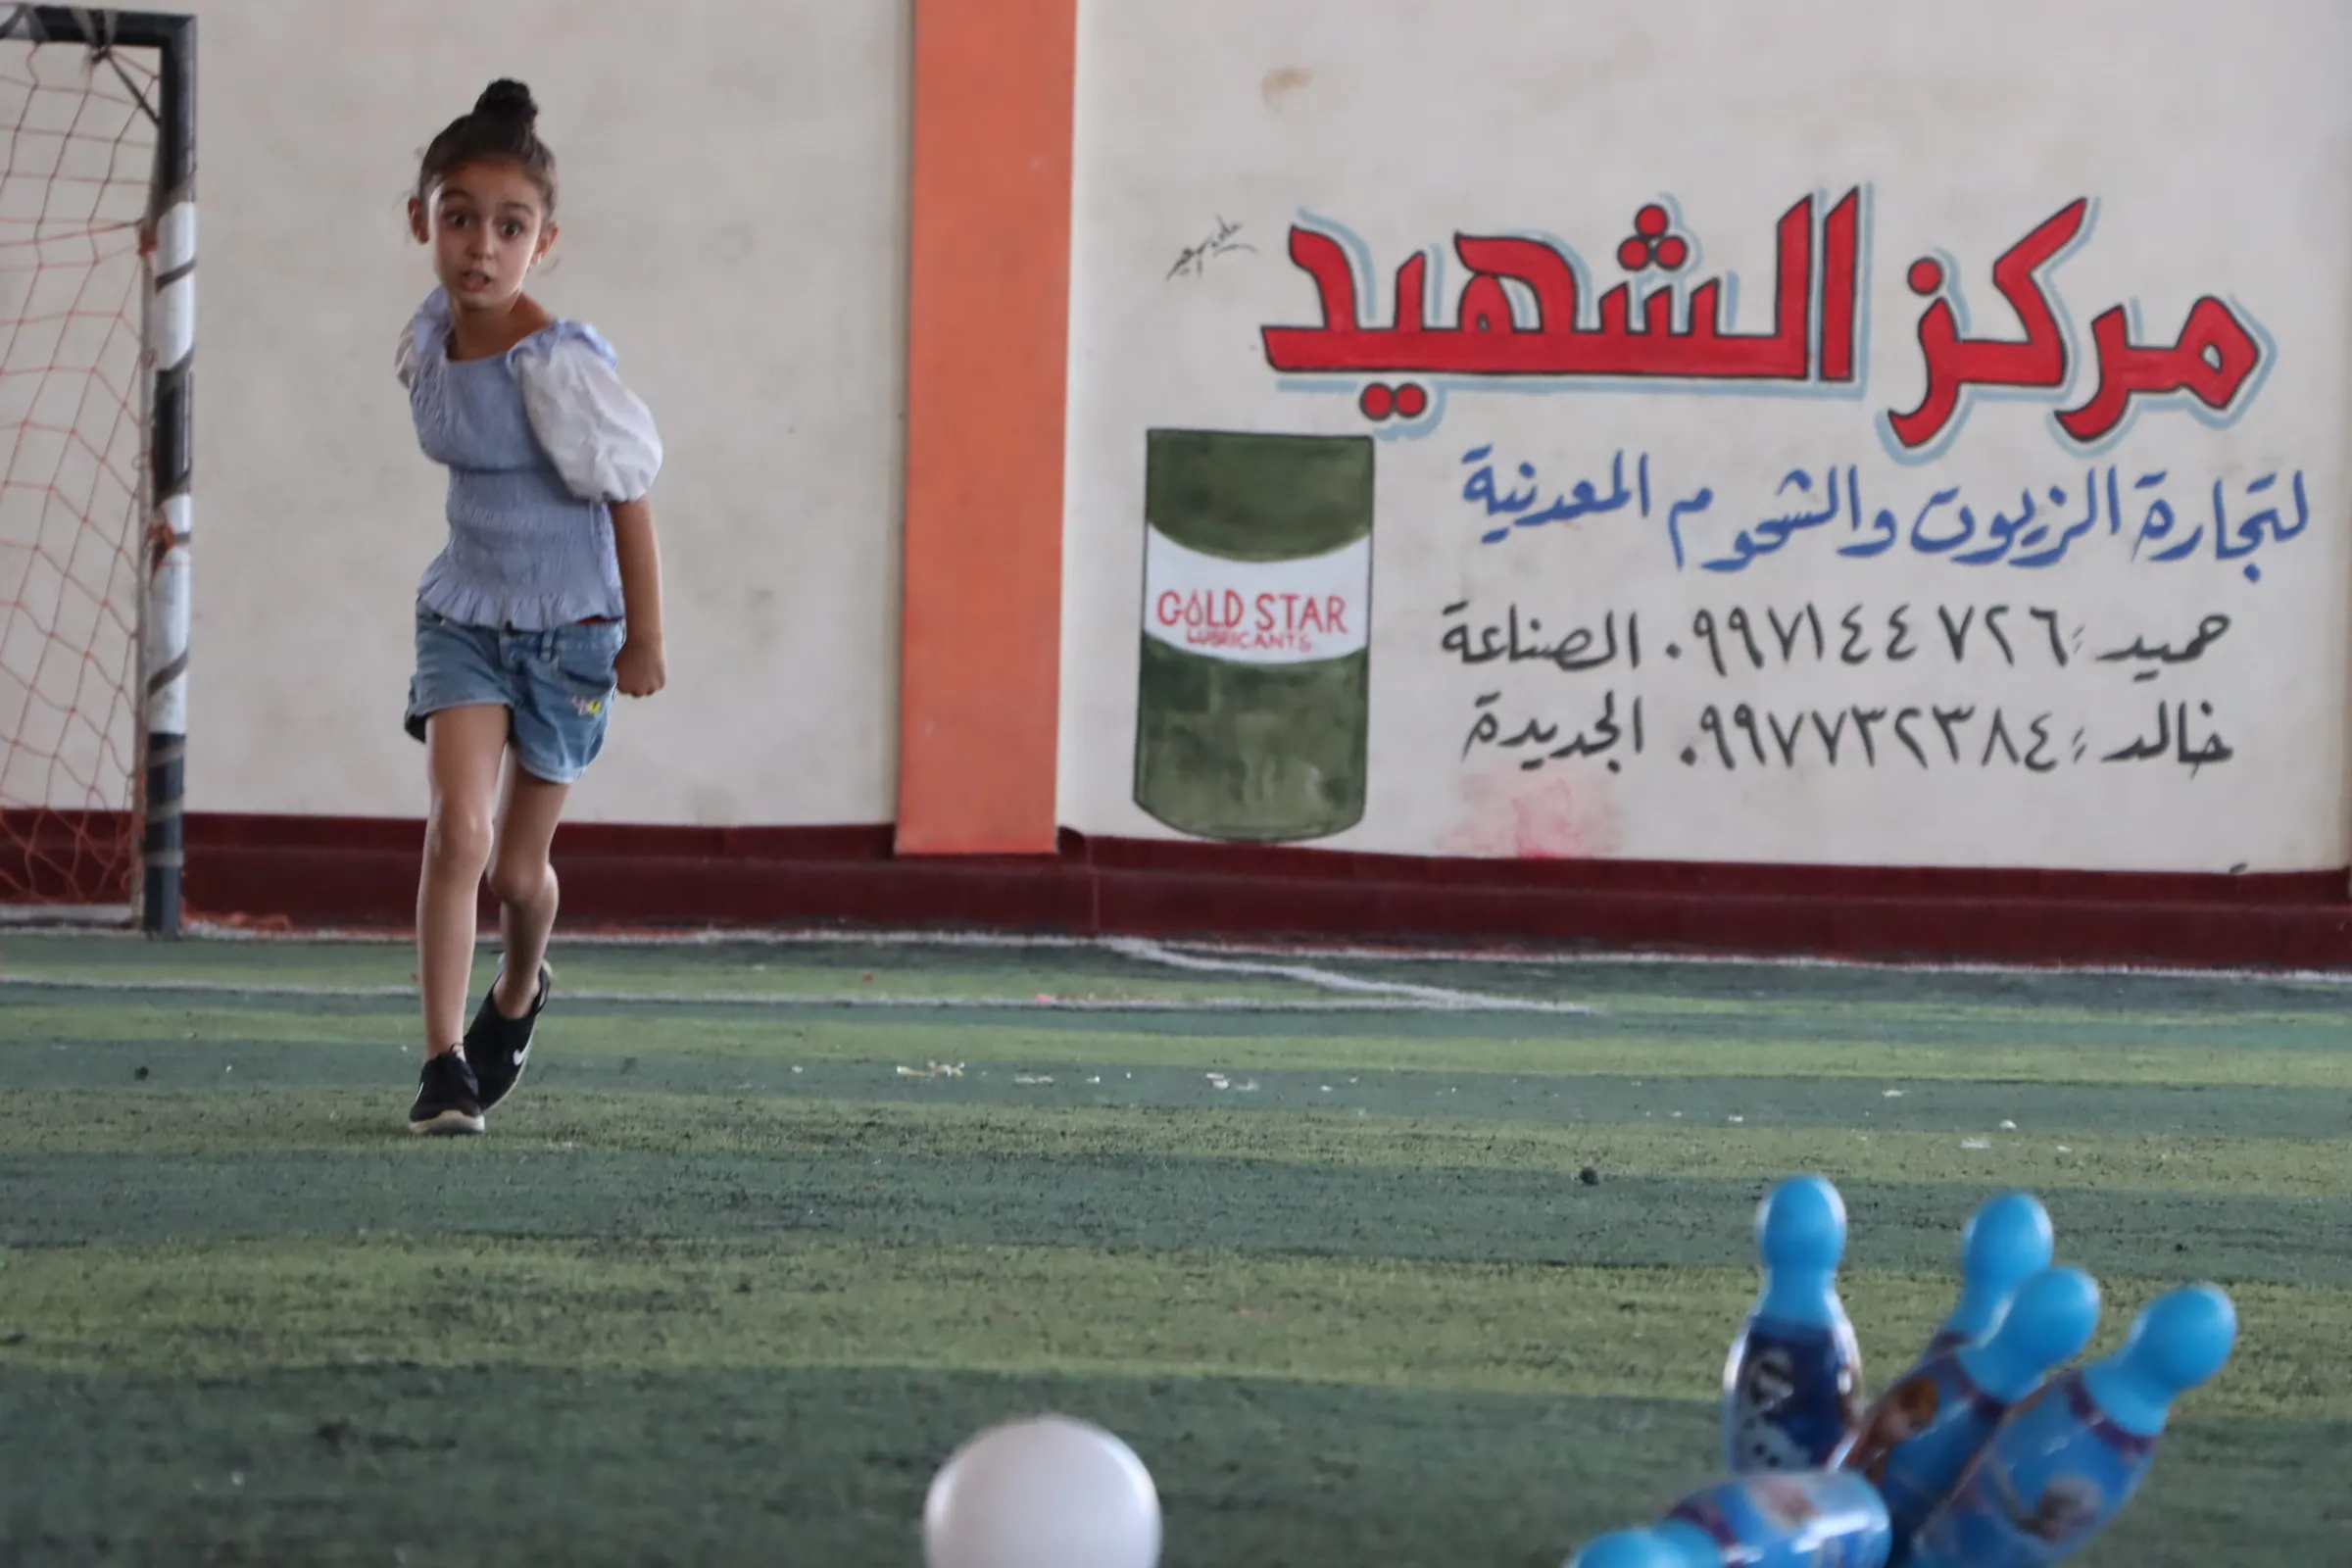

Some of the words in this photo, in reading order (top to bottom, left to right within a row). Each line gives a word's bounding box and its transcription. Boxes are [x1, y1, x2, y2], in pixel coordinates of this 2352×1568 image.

[1260, 186, 1860, 421] الشهيد
[1887, 197, 2260, 448] مركز
[1461, 444, 1650, 544] المعدنية
[1668, 466, 1897, 572] والشحوم
[1910, 466, 2121, 568] الزيوت
[2132, 470, 2309, 581] لتجارة
[1156, 589, 1245, 627] GOLD
[1254, 592, 1348, 634] STAR
[1441, 600, 1641, 672] الصناعة
[1665, 602, 2068, 677] ٠٩٩٧١٤٤٧٢٦
[1461, 690, 1644, 774] الجديدة
[1679, 702, 2058, 773] ٠٩٩٧٧٣٢٣٨٤
